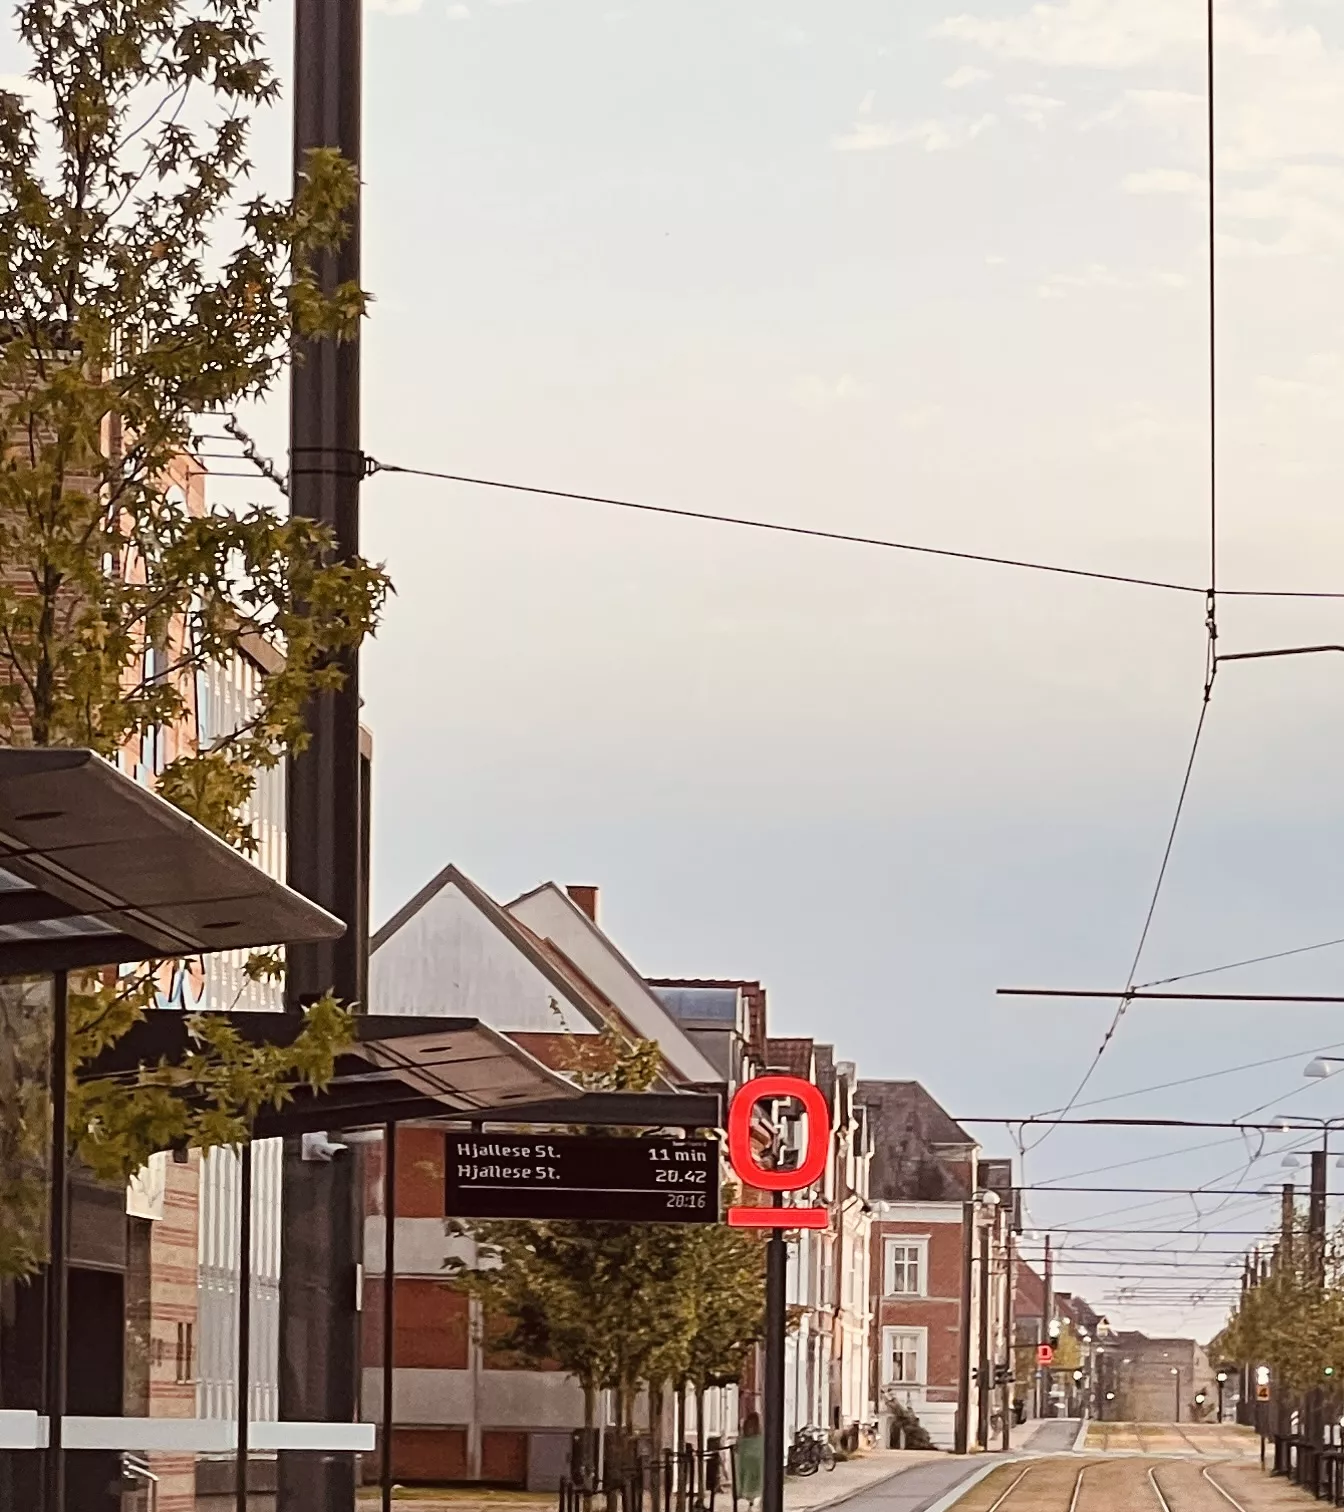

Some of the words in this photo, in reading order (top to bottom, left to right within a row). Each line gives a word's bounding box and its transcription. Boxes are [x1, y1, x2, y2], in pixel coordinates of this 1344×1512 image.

[457, 1143, 531, 1158] Hjallese
[535, 1145, 561, 1158] St.
[648, 1148, 671, 1161] 11
[674, 1149, 707, 1162] min
[457, 1164, 532, 1180] Hjallese
[535, 1166, 561, 1180] St.
[655, 1169, 707, 1184] 20.42
